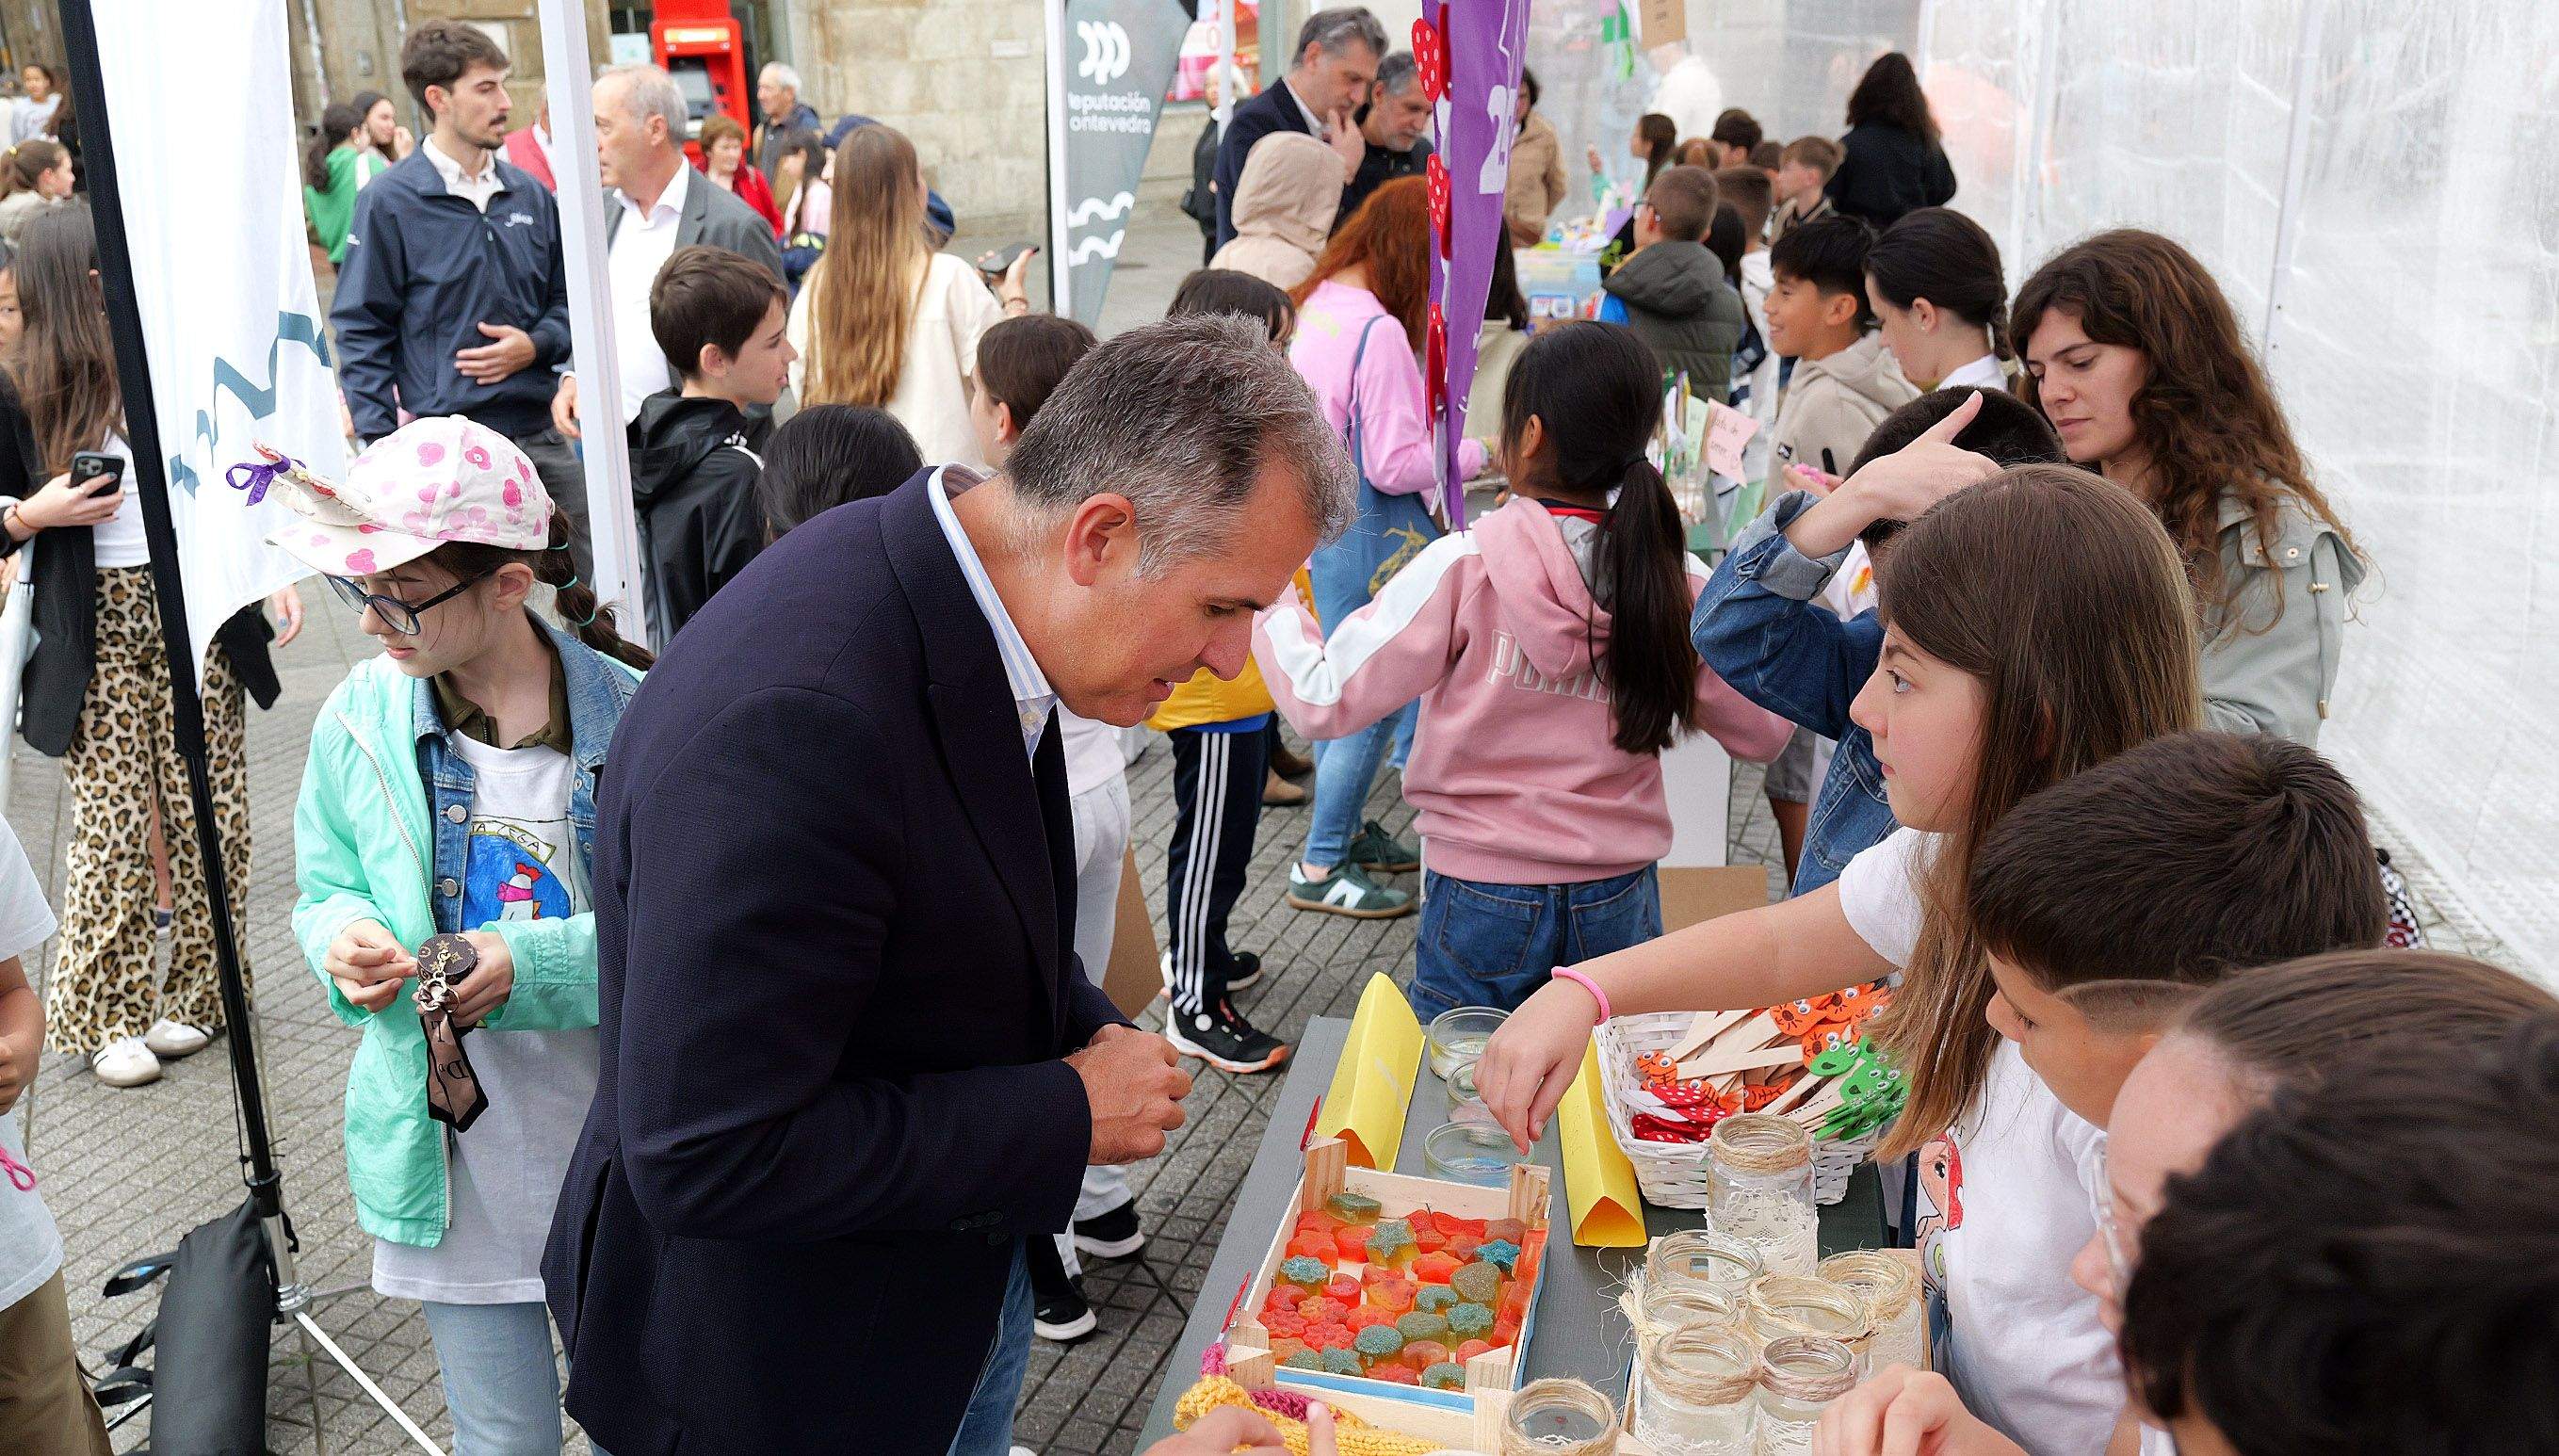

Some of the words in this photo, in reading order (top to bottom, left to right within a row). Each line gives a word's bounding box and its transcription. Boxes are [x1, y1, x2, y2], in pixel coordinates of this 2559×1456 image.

[1068, 90, 1151, 115] eputación
[1069, 113, 1151, 134] ontevedra
[1485, 629, 1617, 704] PU
